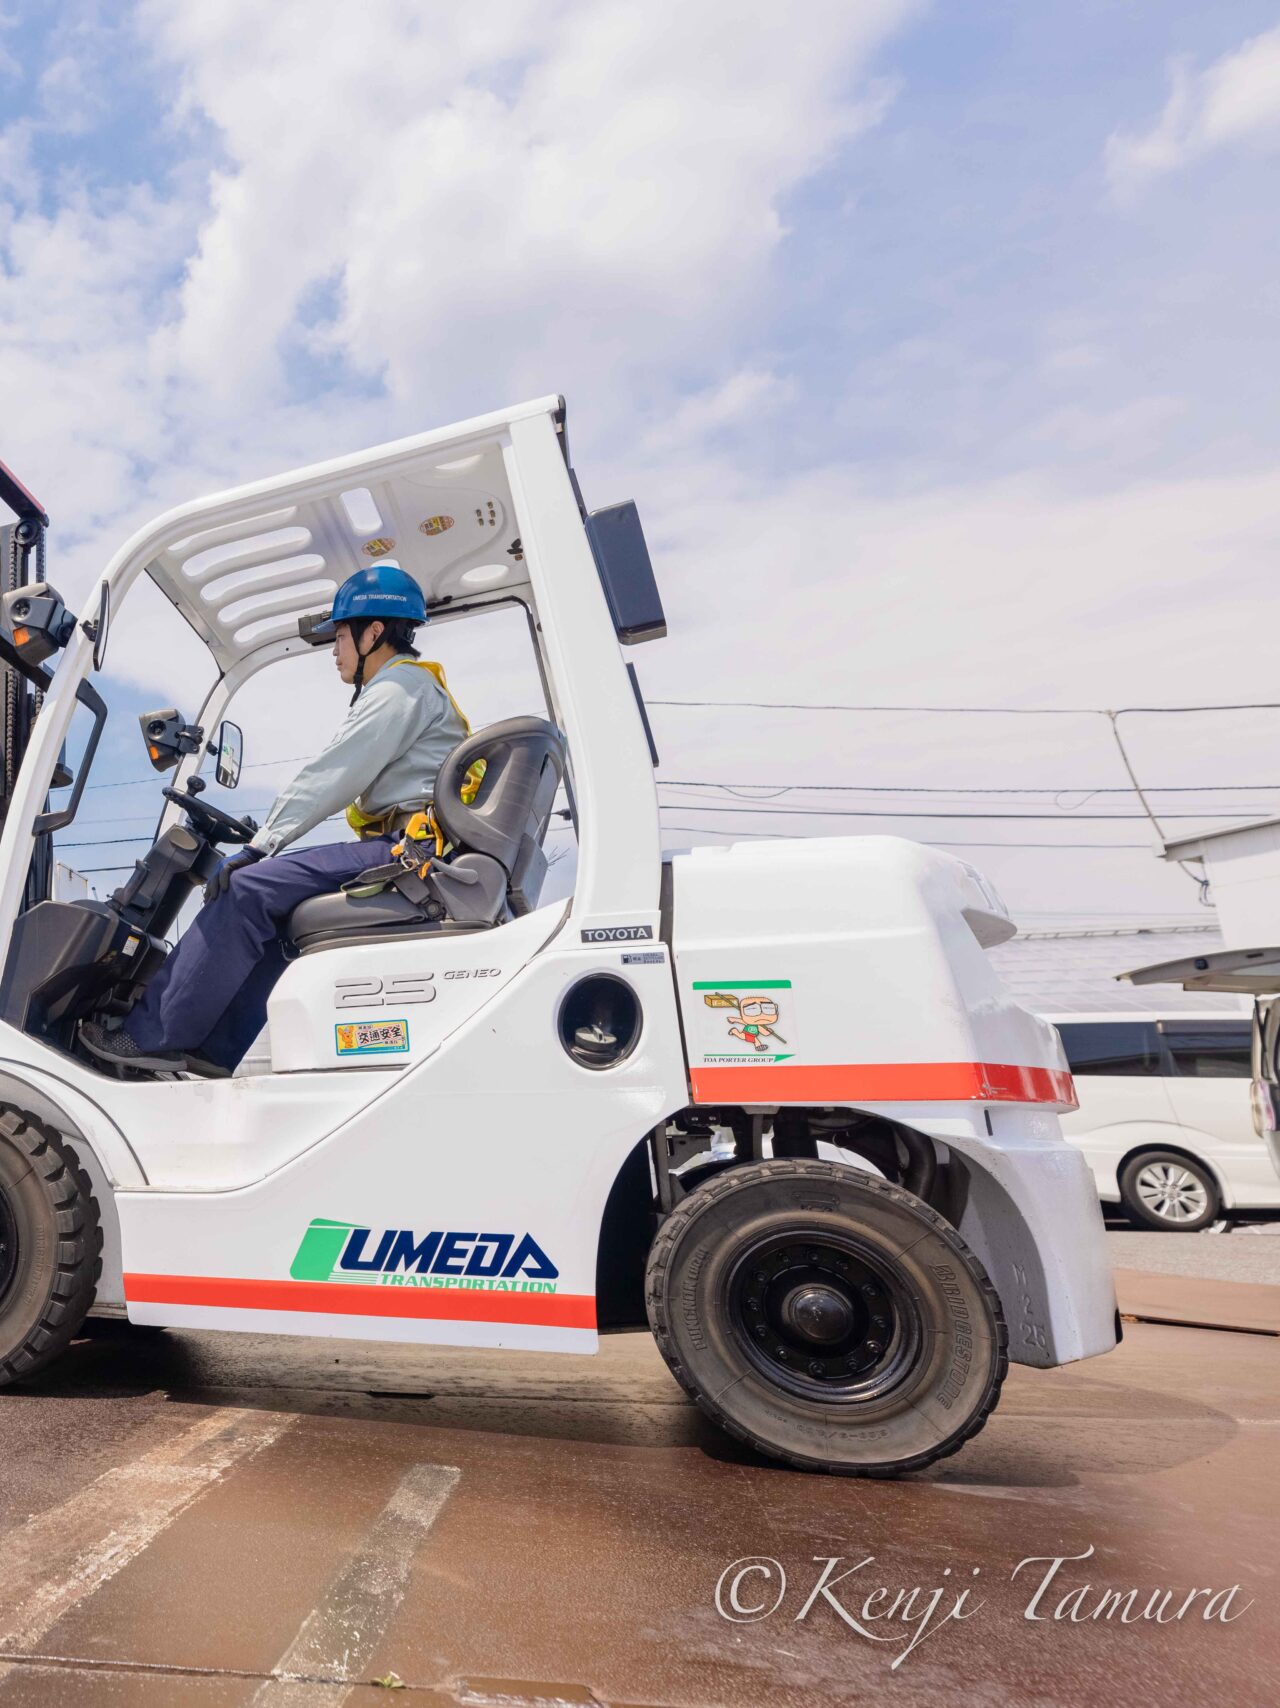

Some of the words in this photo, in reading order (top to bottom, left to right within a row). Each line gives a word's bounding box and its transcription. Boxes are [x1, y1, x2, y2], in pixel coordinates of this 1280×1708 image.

[585, 927, 648, 941] TOYOTA
[335, 972, 437, 1009] 25
[443, 968, 502, 980] GENEO
[358, 1026, 402, 1044] 交通安全
[340, 1229, 560, 1280] UMEDA
[380, 1273, 557, 1294] TRANSPORTATION
[927, 1263, 973, 1411] BRIDGESTONE
